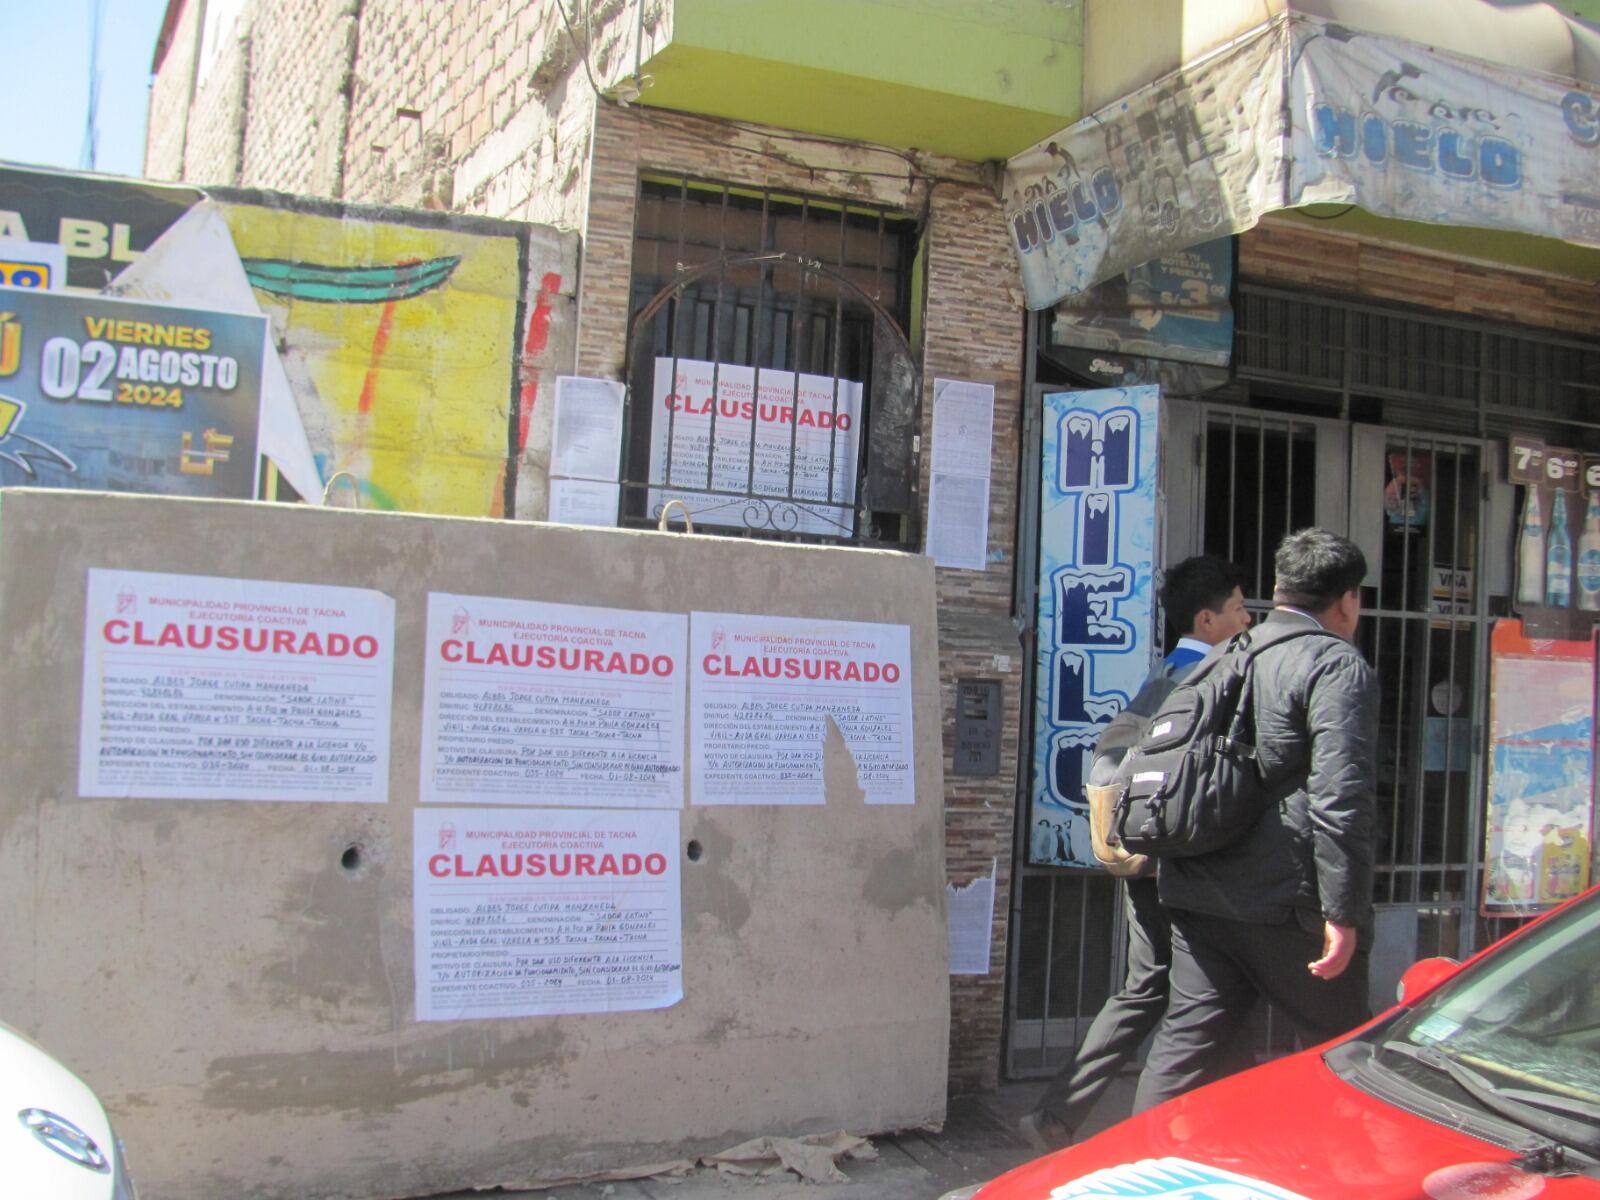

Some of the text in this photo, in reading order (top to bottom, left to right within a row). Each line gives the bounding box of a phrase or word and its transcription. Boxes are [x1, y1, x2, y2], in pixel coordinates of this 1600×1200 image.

[1313, 101, 1524, 191] HIELO
[1012, 165, 1123, 253] HIELO
[84, 315, 212, 350] VIERNES
[40, 336, 238, 402] 02 AGOSTO
[116, 383, 184, 409] 2024
[665, 393, 851, 431] CLAUSURADO
[148, 596, 345, 617] MUNICIPALIDAD PROVINCIAL DE TACNA
[257, 615, 307, 625] COACTIVA
[479, 619, 647, 639] MUNICIPALIDAD PROVINCIAL DE TACNA
[103, 619, 379, 659] CLAUSURADO
[571, 636, 613, 646] COACTIVA
[735, 634, 792, 644] MUNICIPALIDAD
[795, 638, 837, 647] PROVINCIAL
[813, 648, 848, 656] COACTIVA
[440, 639, 674, 677] CLAUSURADO
[703, 654, 900, 683] CLAUSURADO
[466, 831, 536, 839] MUNICIPALIDAD
[429, 854, 667, 876] CLAUSURADO
